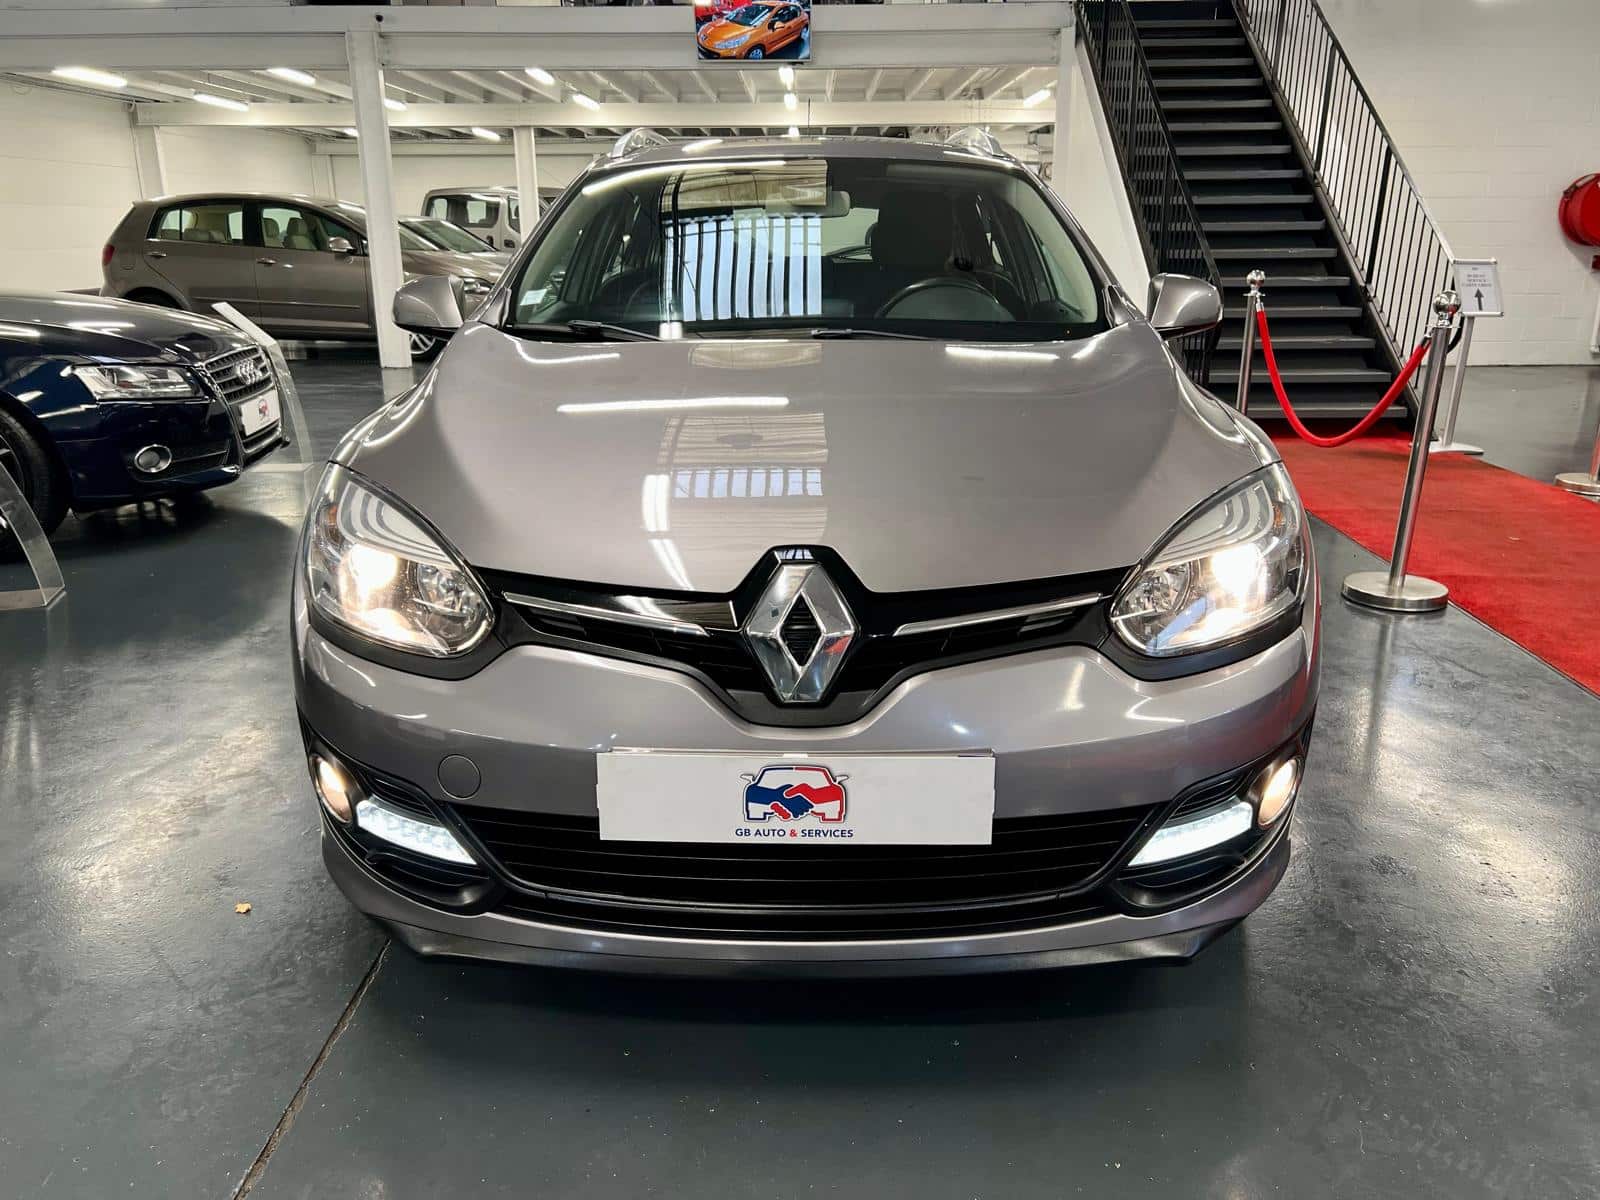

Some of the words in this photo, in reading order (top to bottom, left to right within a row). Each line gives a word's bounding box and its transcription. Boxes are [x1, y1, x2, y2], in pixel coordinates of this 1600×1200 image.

[735, 828, 751, 837] GB
[754, 828, 786, 837] AUTO
[789, 829, 798, 838] &
[801, 829, 853, 838] SERVICES
